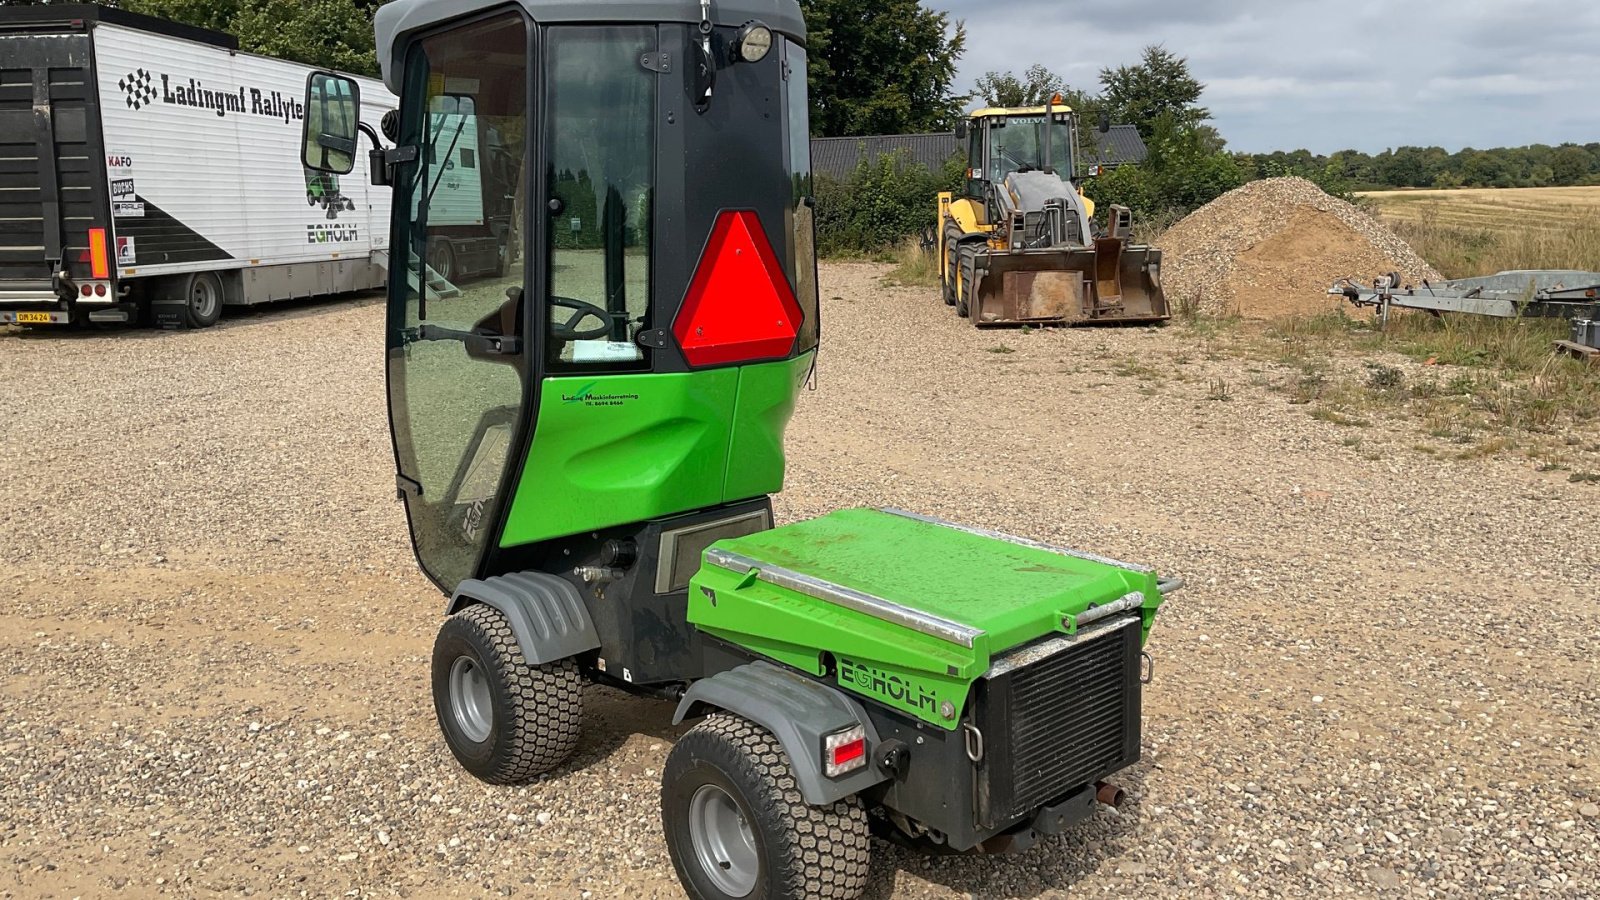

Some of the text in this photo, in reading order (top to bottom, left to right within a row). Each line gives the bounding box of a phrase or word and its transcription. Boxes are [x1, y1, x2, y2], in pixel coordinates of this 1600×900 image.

[250, 87, 304, 125] Rallyte
[108, 156, 132, 167] KAFO
[307, 223, 358, 243] EGHOLM
[841, 658, 936, 713] EGHOLM
